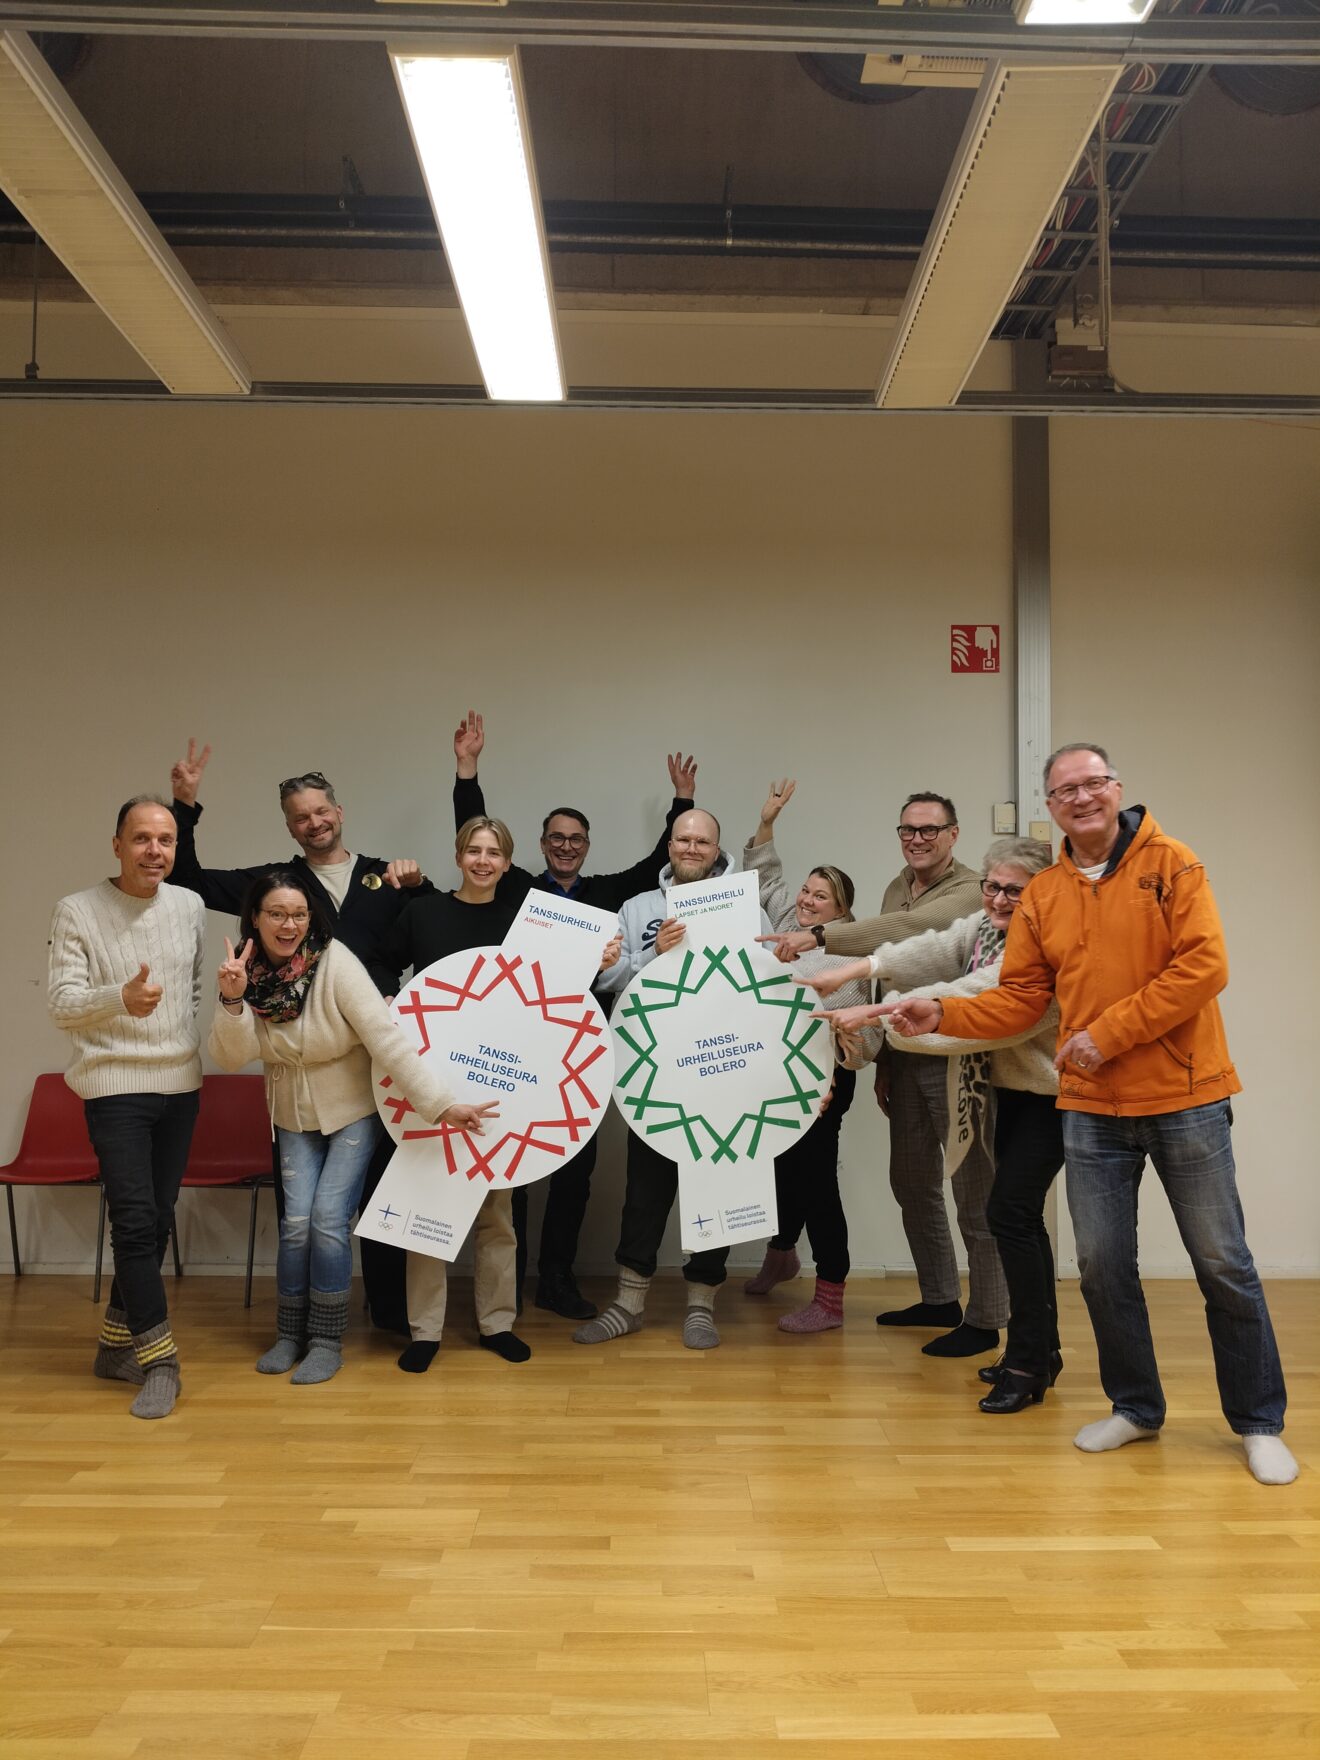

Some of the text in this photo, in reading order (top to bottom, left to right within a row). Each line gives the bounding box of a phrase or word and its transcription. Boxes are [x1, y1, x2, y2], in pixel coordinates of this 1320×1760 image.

[674, 888, 744, 909] TANSSIURHEILU
[529, 905, 601, 933] TANSSIURHEILU
[675, 902, 734, 919] LAPSET JA NUORET
[524, 916, 553, 929] AIKUISET
[695, 1033, 739, 1050] TANSSI-
[479, 1044, 522, 1064] TANSSI-
[676, 1041, 764, 1068] URHEILUSEURA
[449, 1051, 538, 1085] URHEILUSEURA
[699, 1058, 747, 1077] BOLERO
[466, 1071, 515, 1092] BOLERO
[724, 1204, 761, 1216] Suomalainen
[726, 1209, 766, 1223] urheilu loistaa
[412, 1222, 453, 1238] urheilu loistaa
[415, 1214, 452, 1230] Suomalainen
